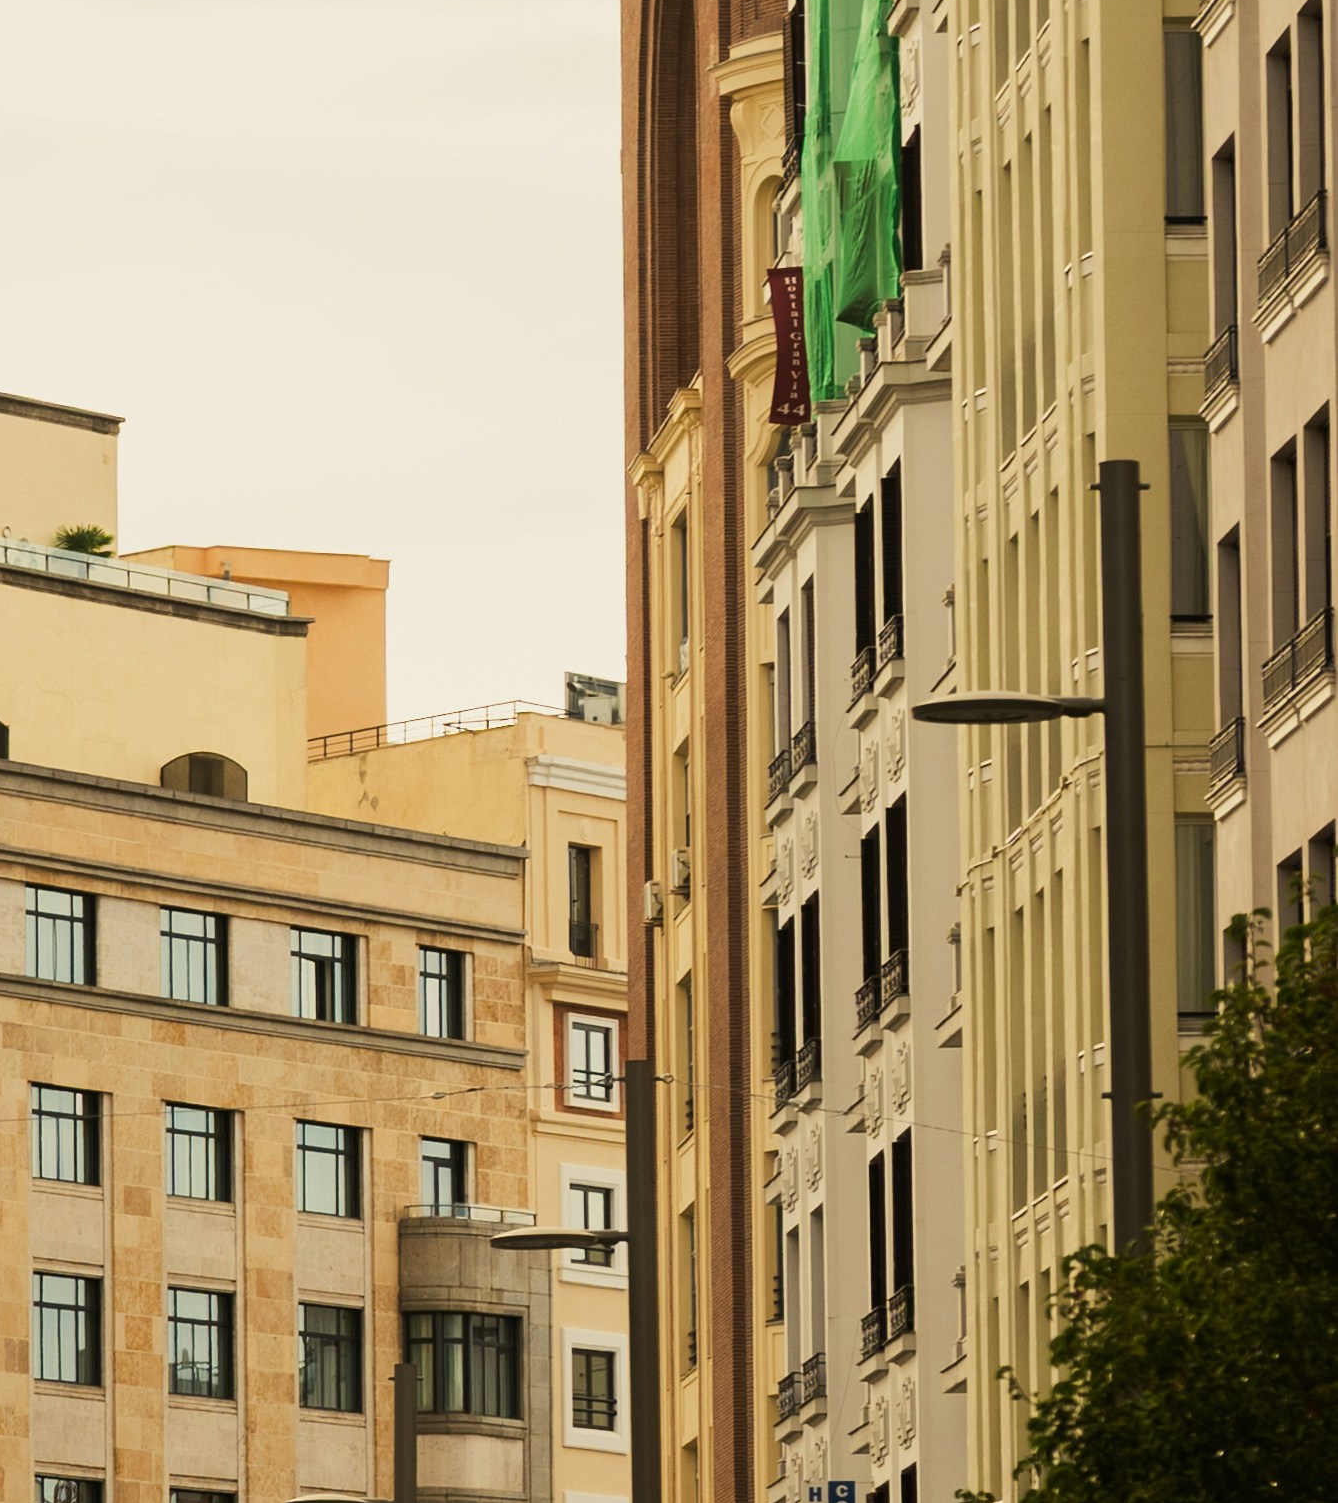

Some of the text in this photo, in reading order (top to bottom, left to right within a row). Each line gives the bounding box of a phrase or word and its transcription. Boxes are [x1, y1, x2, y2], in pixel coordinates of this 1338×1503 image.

[783, 277, 799, 328] Hostal
[790, 332, 802, 366] Gran
[777, 403, 806, 416] 44
